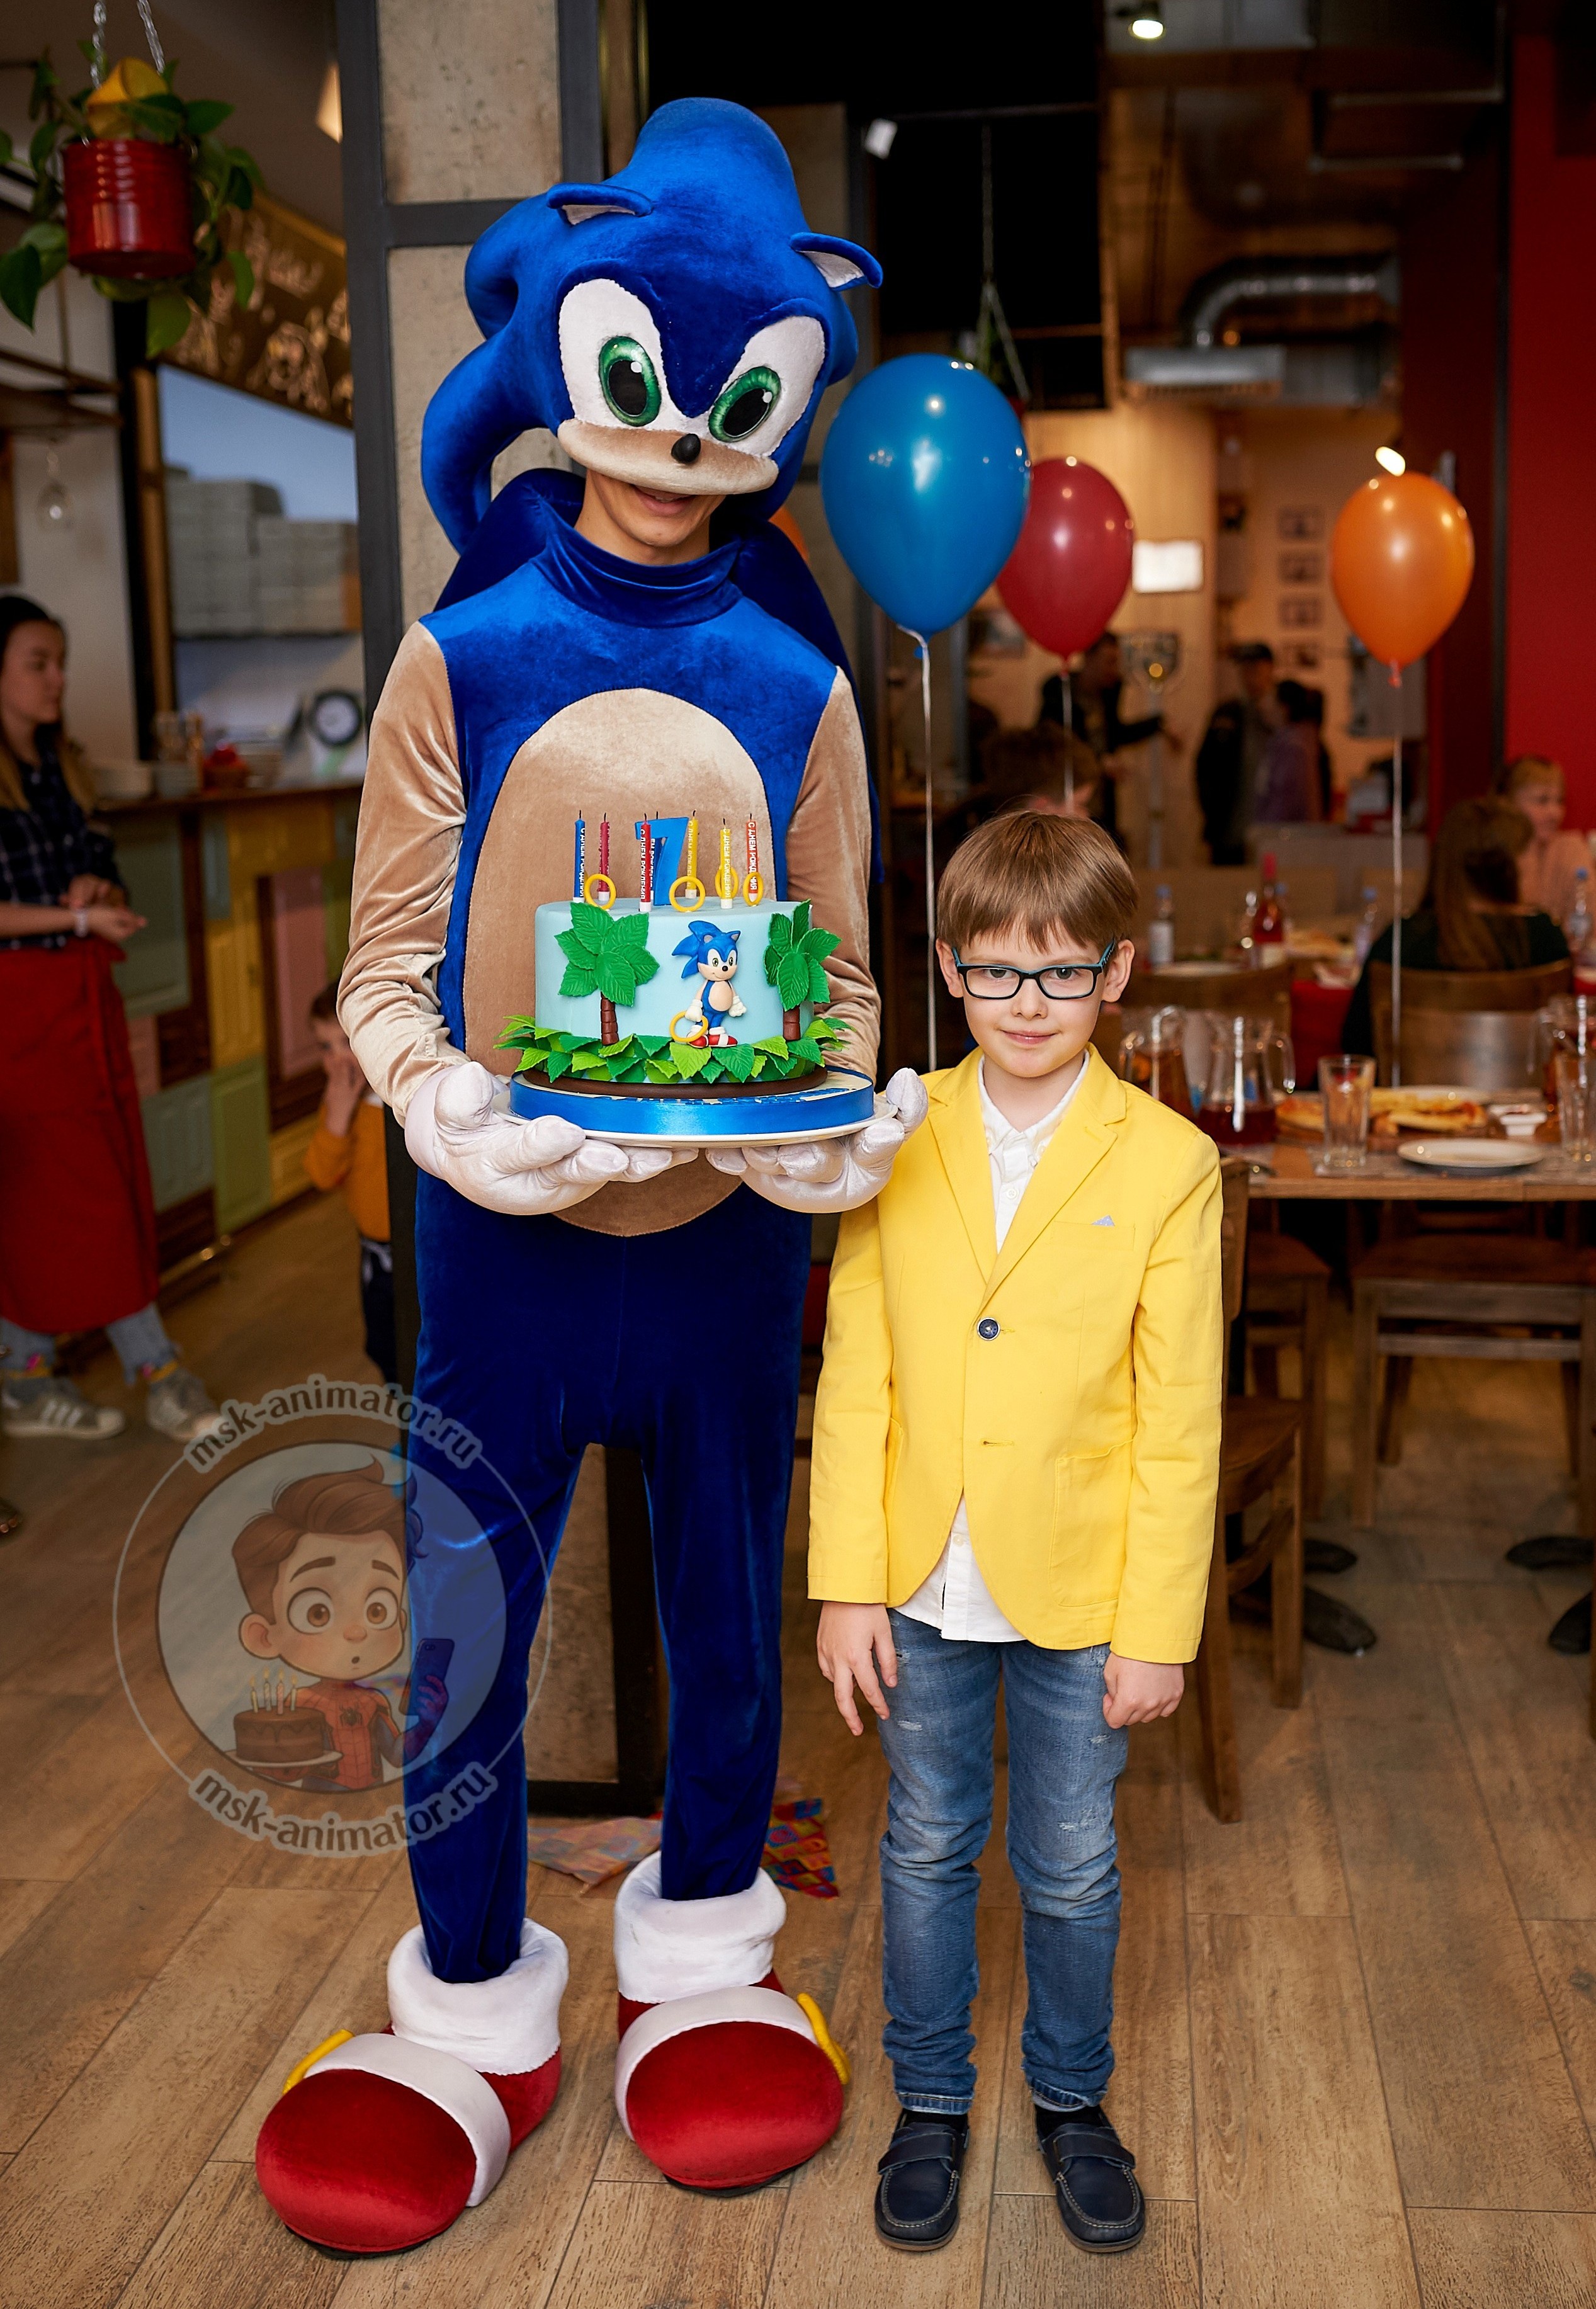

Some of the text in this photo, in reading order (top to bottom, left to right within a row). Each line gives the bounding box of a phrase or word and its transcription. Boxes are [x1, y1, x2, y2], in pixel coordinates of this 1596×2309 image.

[748, 829, 756, 850] ДНЕМ
[635, 817, 689, 906] 7
[749, 852, 757, 890] РОЖДИЯ
